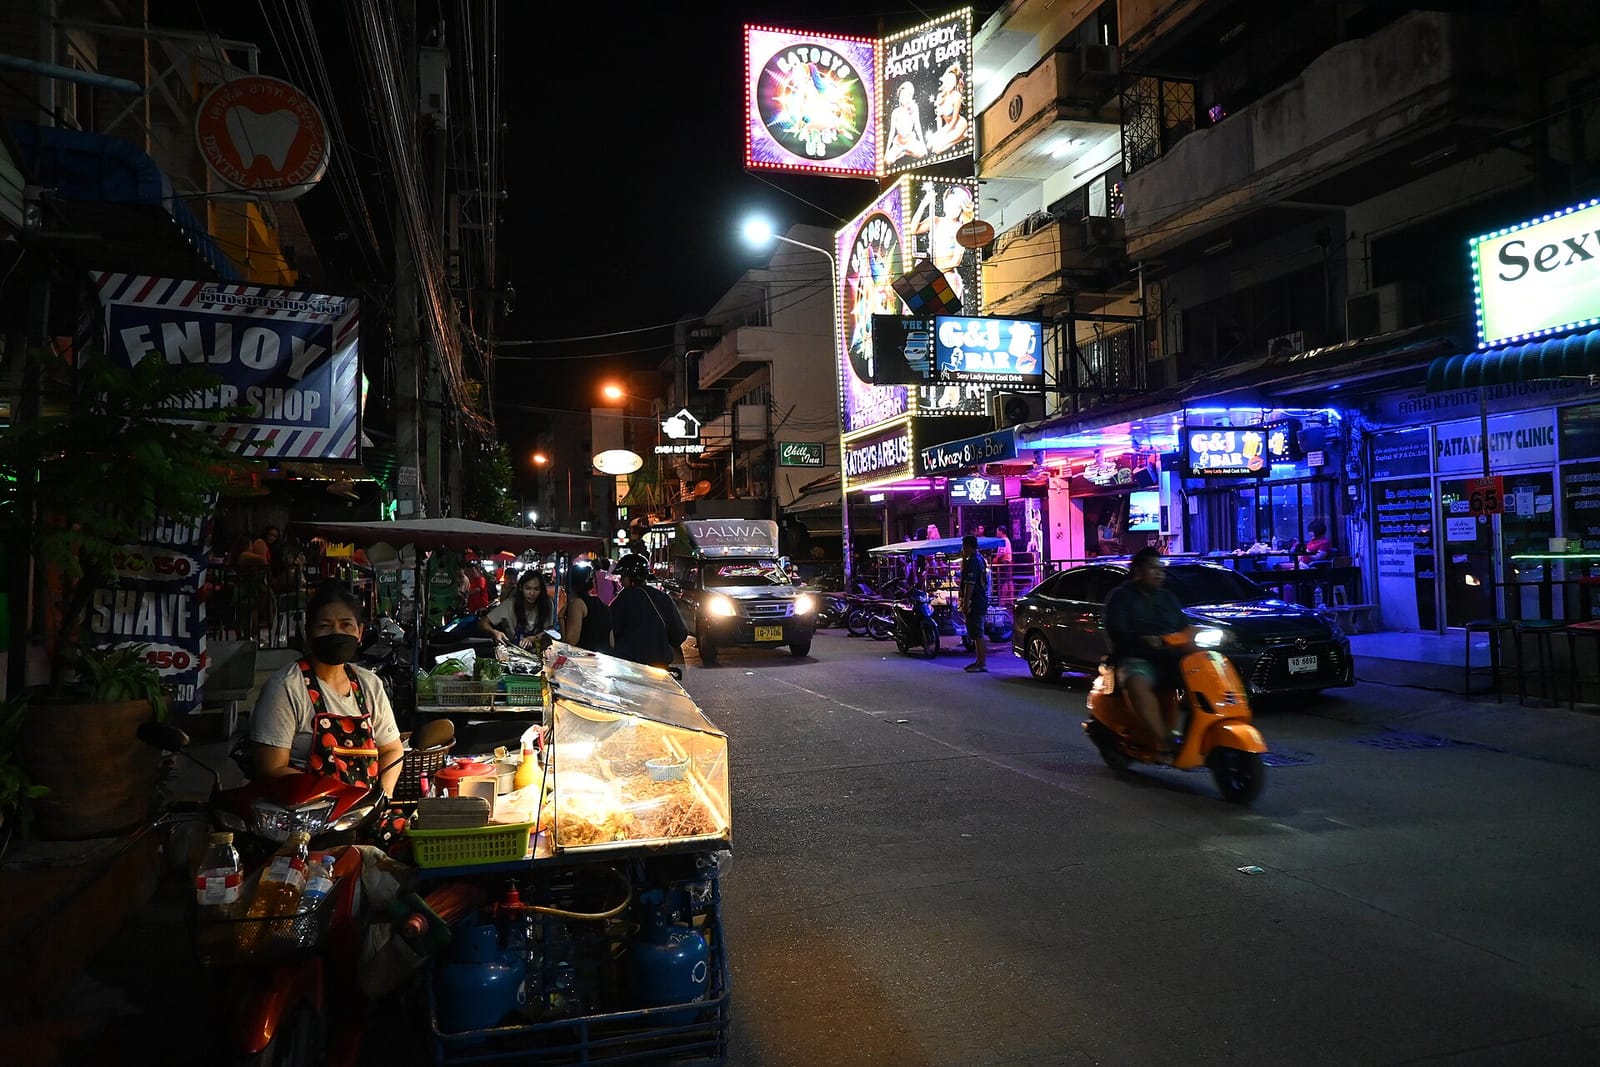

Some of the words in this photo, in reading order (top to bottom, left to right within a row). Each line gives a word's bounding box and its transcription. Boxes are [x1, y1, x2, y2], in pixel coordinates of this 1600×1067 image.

[891, 24, 958, 60] LADYBOY
[886, 50, 932, 80] PARTY
[935, 40, 966, 63] BAR
[202, 135, 249, 185] DENTAL
[252, 177, 286, 189] ART
[287, 143, 322, 184] CLINIC
[902, 320, 922, 329] THE
[120, 321, 327, 380] ENJOY
[964, 351, 1010, 369] BAR
[956, 372, 969, 381] Sexy
[970, 372, 983, 382] Lady
[984, 373, 995, 381] And
[1009, 374, 1023, 382] Drink
[245, 386, 321, 422] SHOP
[783, 445, 808, 458] Chill
[1437, 434, 1485, 457] PATTAYA
[1489, 430, 1513, 452] CITY
[1516, 425, 1554, 449] CLINIC
[804, 453, 820, 464] Inn
[921, 450, 937, 471] The
[1209, 453, 1243, 467] BAR
[1471, 490, 1497, 511] 65
[693, 526, 767, 538] JALWA
[91, 587, 191, 639] SHAVE
